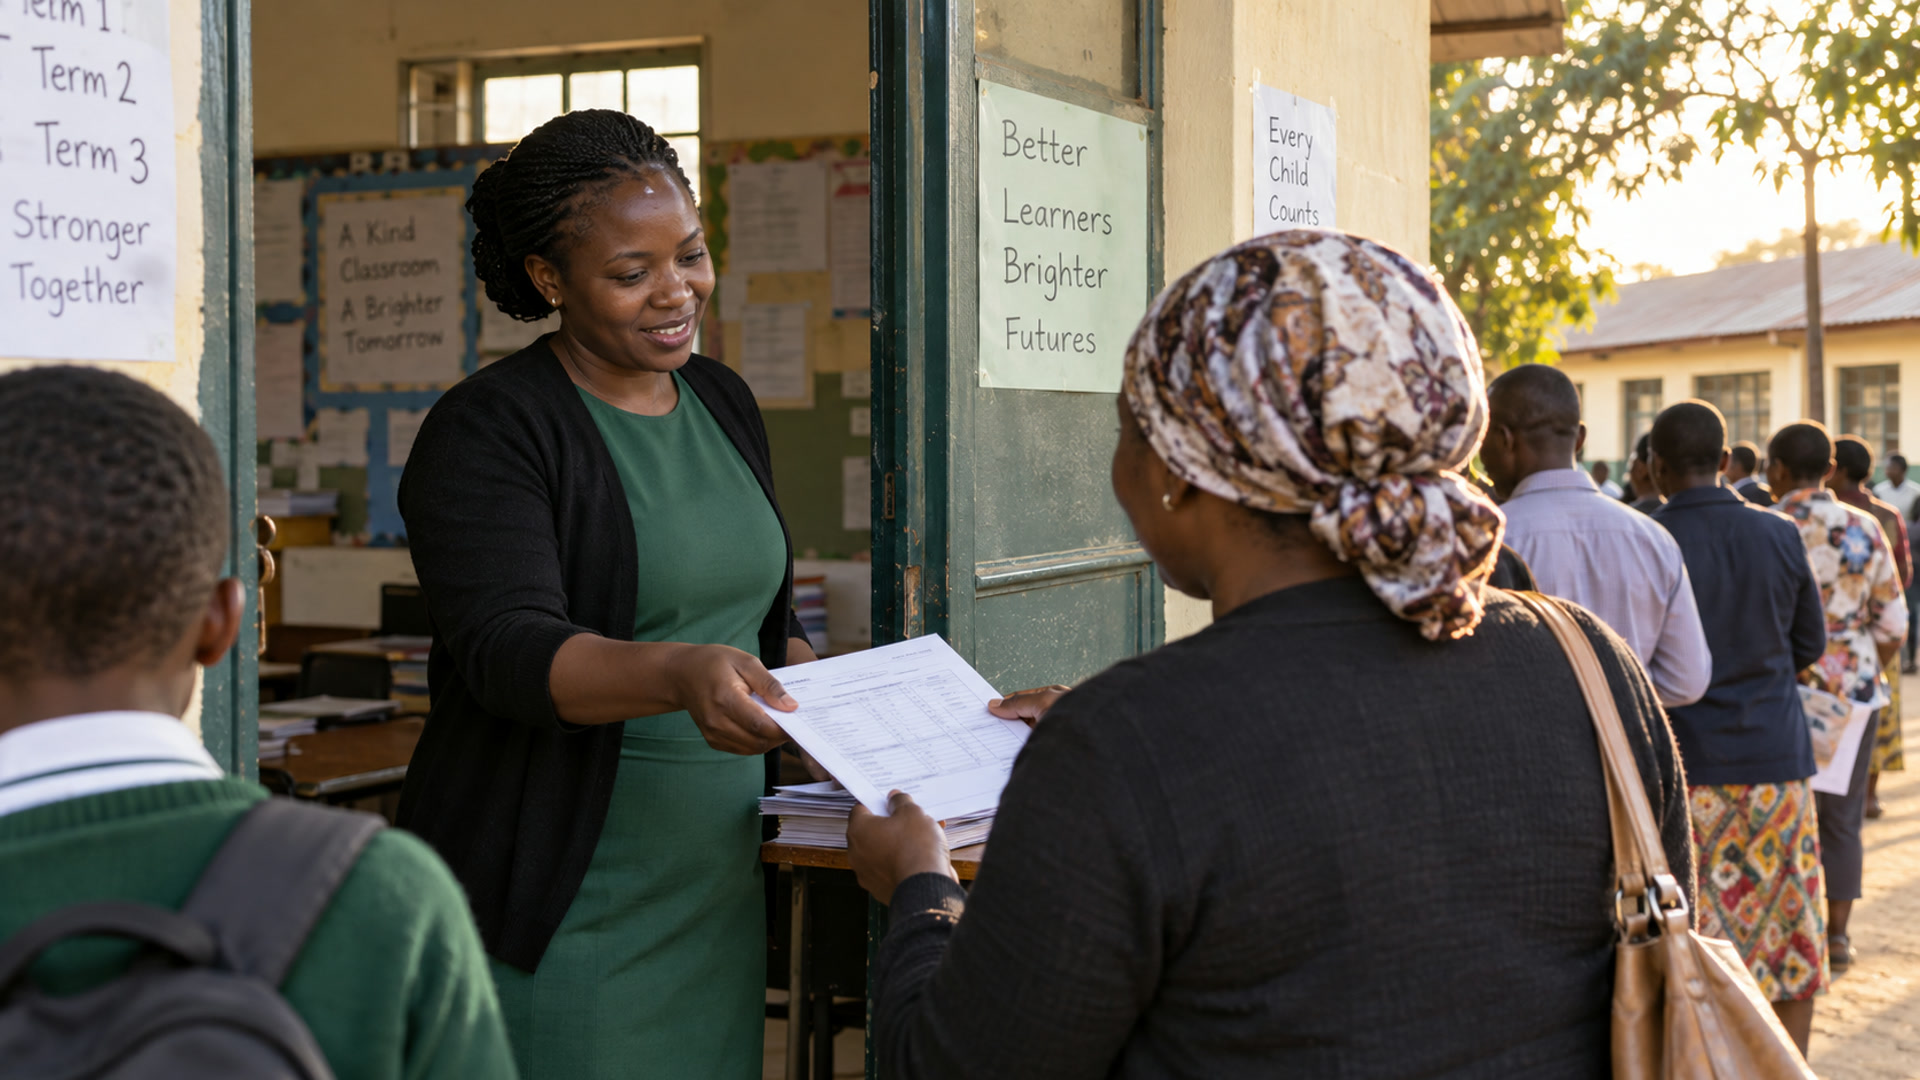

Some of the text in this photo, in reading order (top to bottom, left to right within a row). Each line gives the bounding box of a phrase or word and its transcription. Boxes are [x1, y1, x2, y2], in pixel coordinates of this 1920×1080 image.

[32, 46, 136, 105] Term 2
[34, 121, 149, 184] Term 3
[1002, 119, 1088, 167] Better
[1269, 116, 1313, 161] Every
[1269, 156, 1309, 187] Child
[14, 199, 150, 260] Stronger
[339, 216, 416, 247] A Kind
[1003, 188, 1112, 235] Learners
[1269, 195, 1319, 226] Counts
[10, 262, 144, 317] Together
[340, 257, 440, 283] Classroom
[1004, 247, 1108, 301] Brighter
[340, 292, 443, 327] A Brighter
[343, 328, 444, 354] Tomorrow
[1005, 317, 1096, 354] Futures
